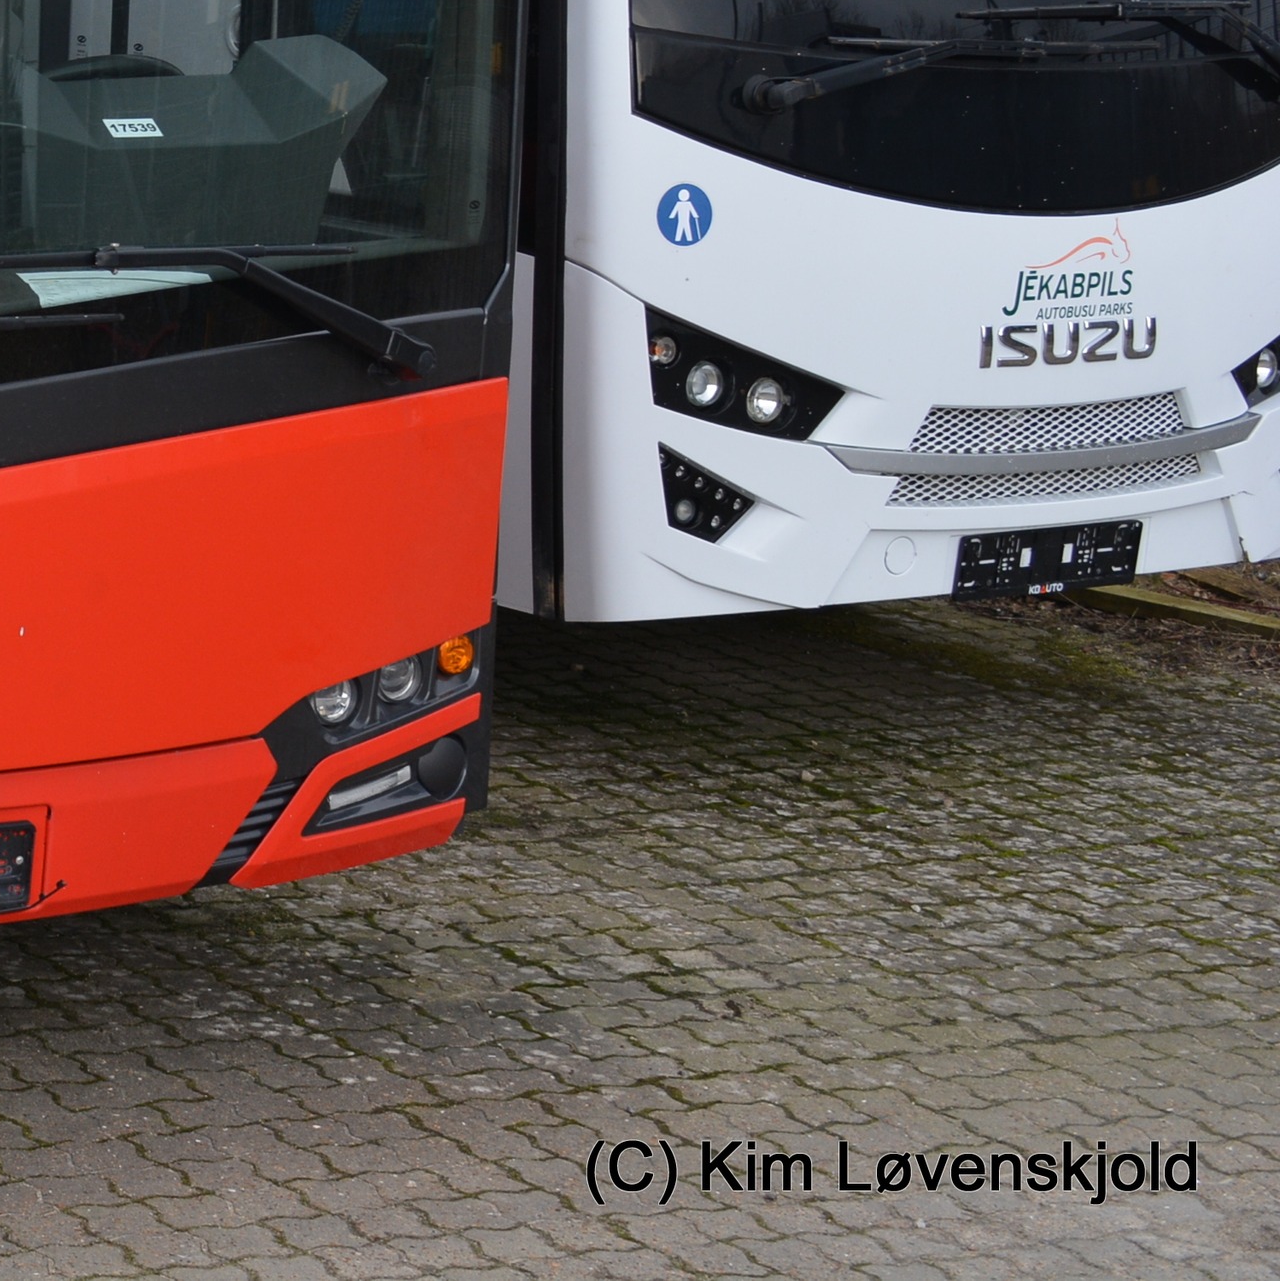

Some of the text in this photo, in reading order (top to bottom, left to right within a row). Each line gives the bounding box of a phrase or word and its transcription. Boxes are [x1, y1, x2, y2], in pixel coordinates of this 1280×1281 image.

[109, 123, 157, 133] 17539
[1002, 269, 1134, 317] JĒKABPILS
[1036, 302, 1133, 320] AUTOBUSU PARKS
[979, 316, 1157, 369] ISUZU
